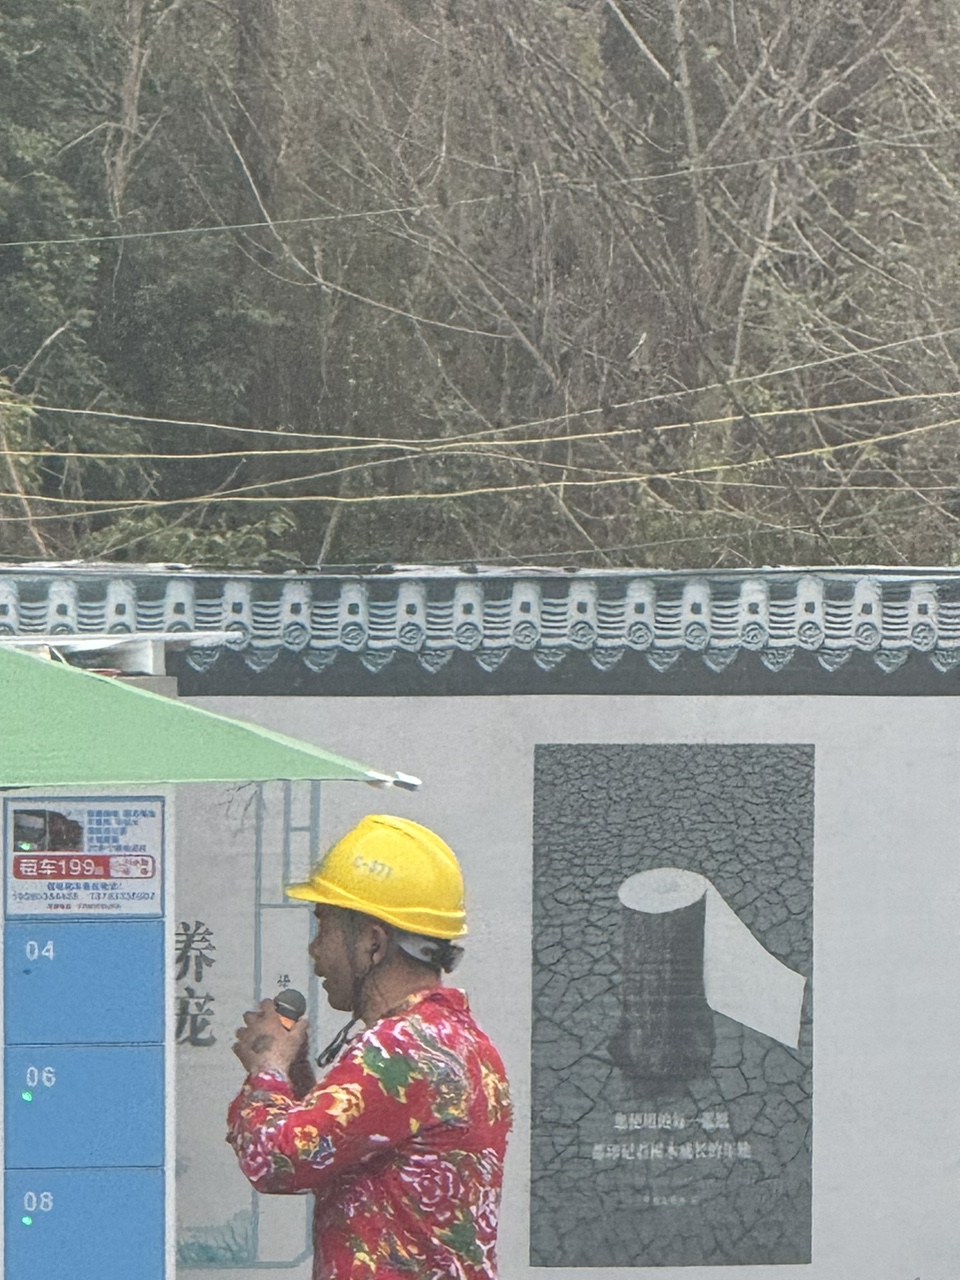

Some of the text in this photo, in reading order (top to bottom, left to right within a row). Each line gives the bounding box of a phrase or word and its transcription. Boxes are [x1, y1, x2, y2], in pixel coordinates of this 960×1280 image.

[26, 941, 54, 961] 04
[175, 921, 217, 1047] 养宠
[26, 1066, 56, 1087] 06
[23, 1191, 53, 1212] 08
